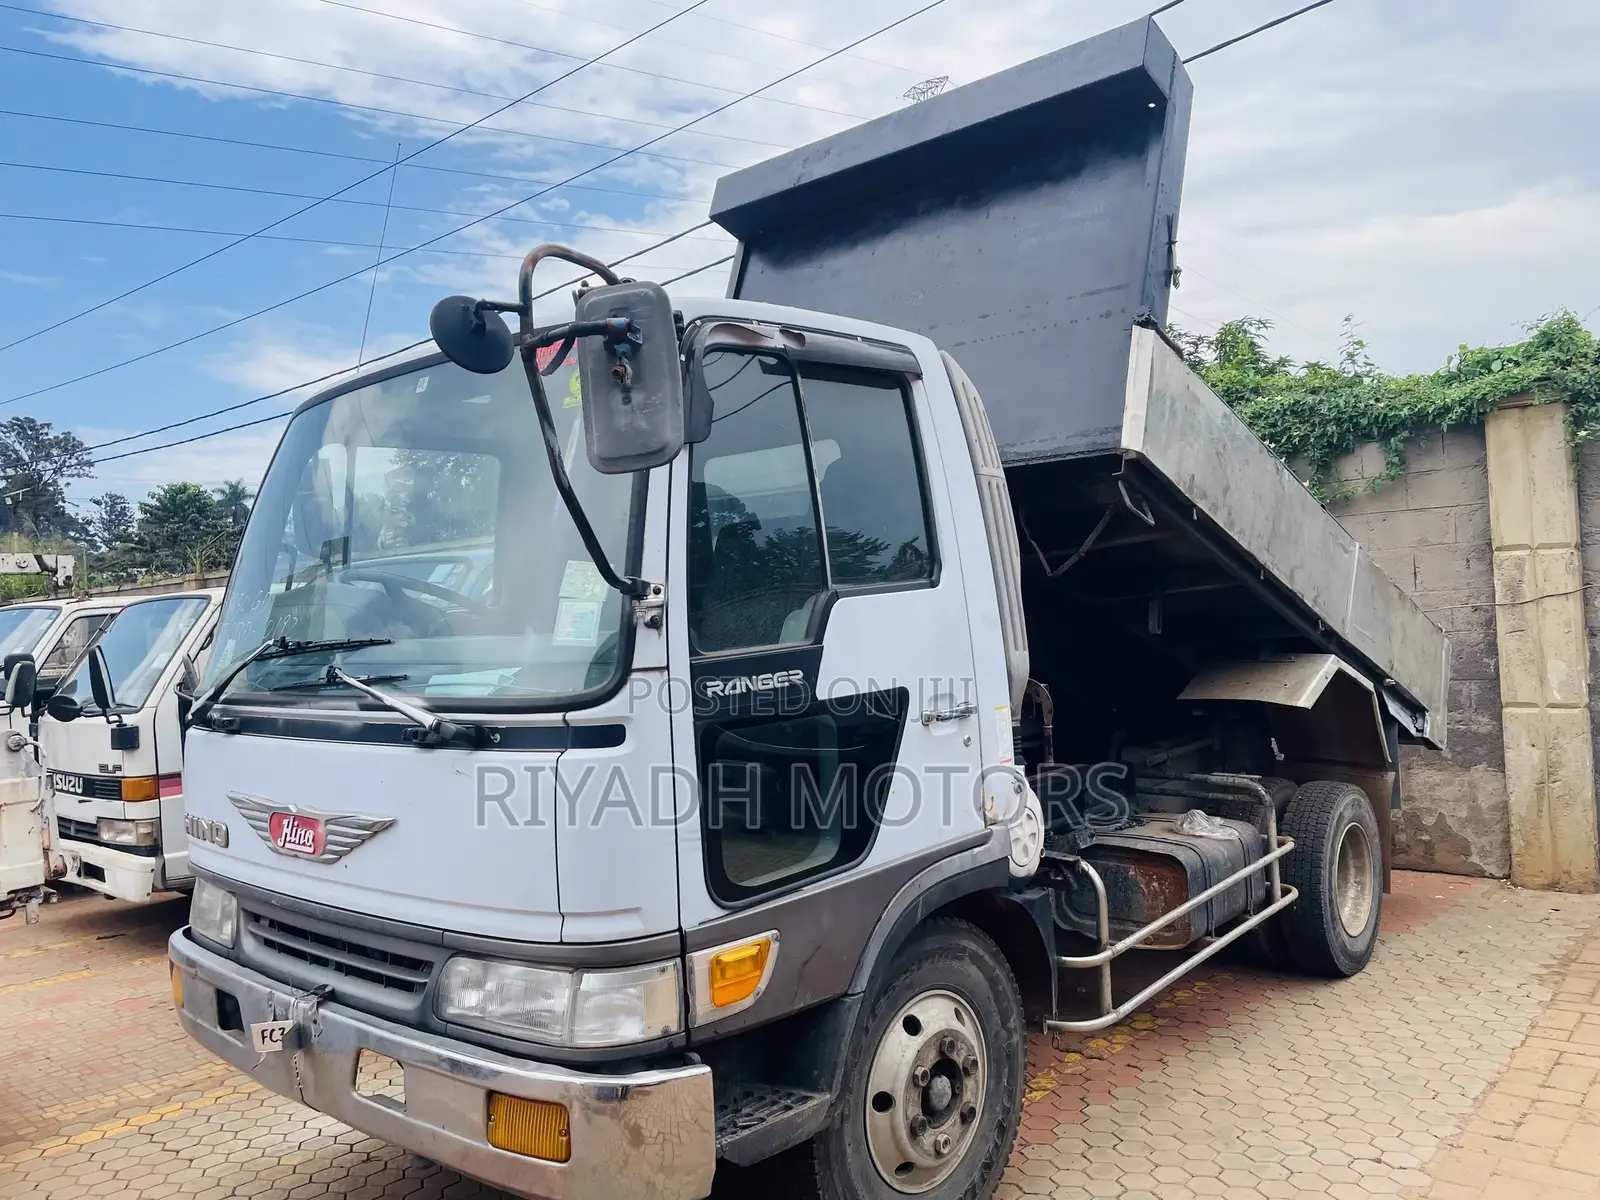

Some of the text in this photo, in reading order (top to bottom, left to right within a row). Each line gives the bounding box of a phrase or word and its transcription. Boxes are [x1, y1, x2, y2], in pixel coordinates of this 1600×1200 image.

[706, 669, 804, 698] RANGER
[53, 773, 83, 794] ISUZU
[184, 813, 229, 848] HINO
[278, 815, 316, 853] Hino
